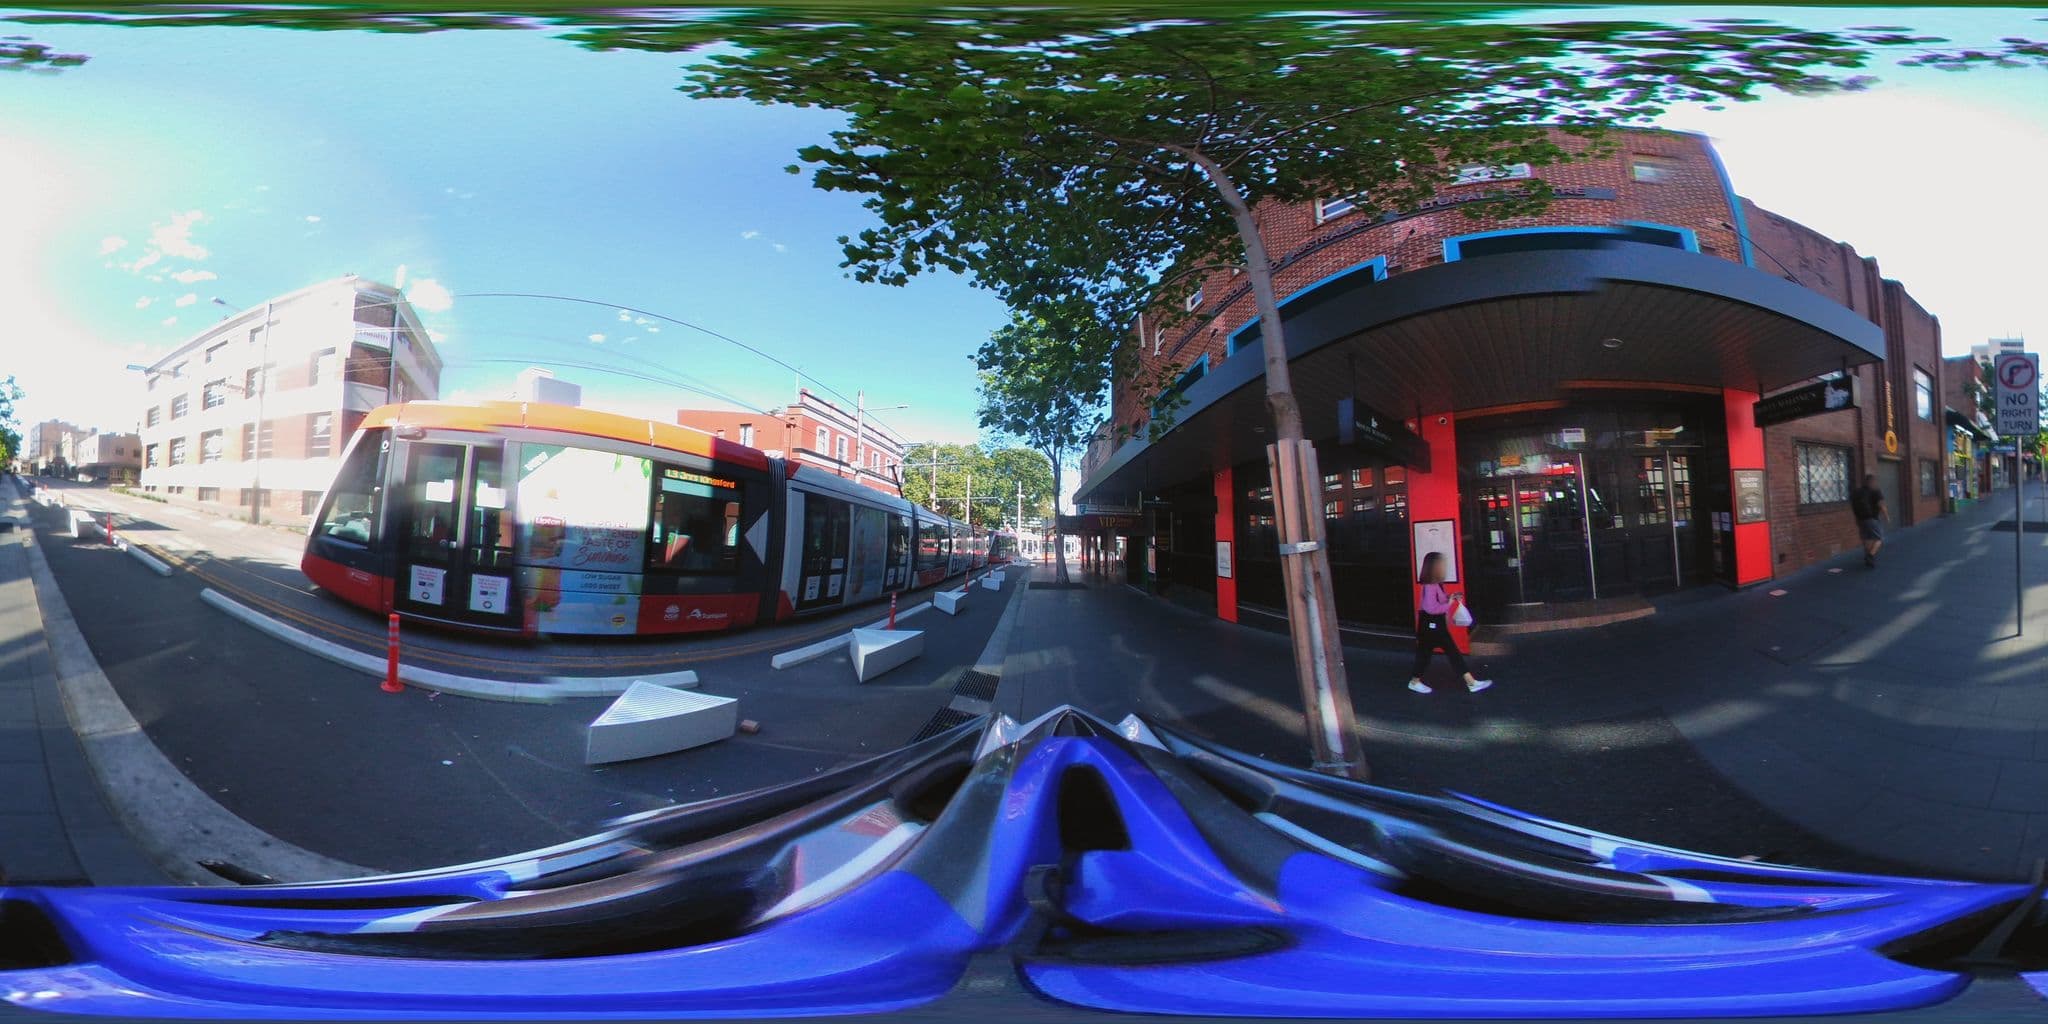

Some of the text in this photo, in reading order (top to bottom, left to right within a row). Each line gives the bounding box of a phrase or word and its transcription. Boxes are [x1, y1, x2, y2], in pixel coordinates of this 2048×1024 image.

[2006, 393, 2028, 405] NO
[2001, 408, 2032, 417] RIGHT
[2003, 421, 2032, 430] TURN
[1099, 516, 1116, 527] VIP
